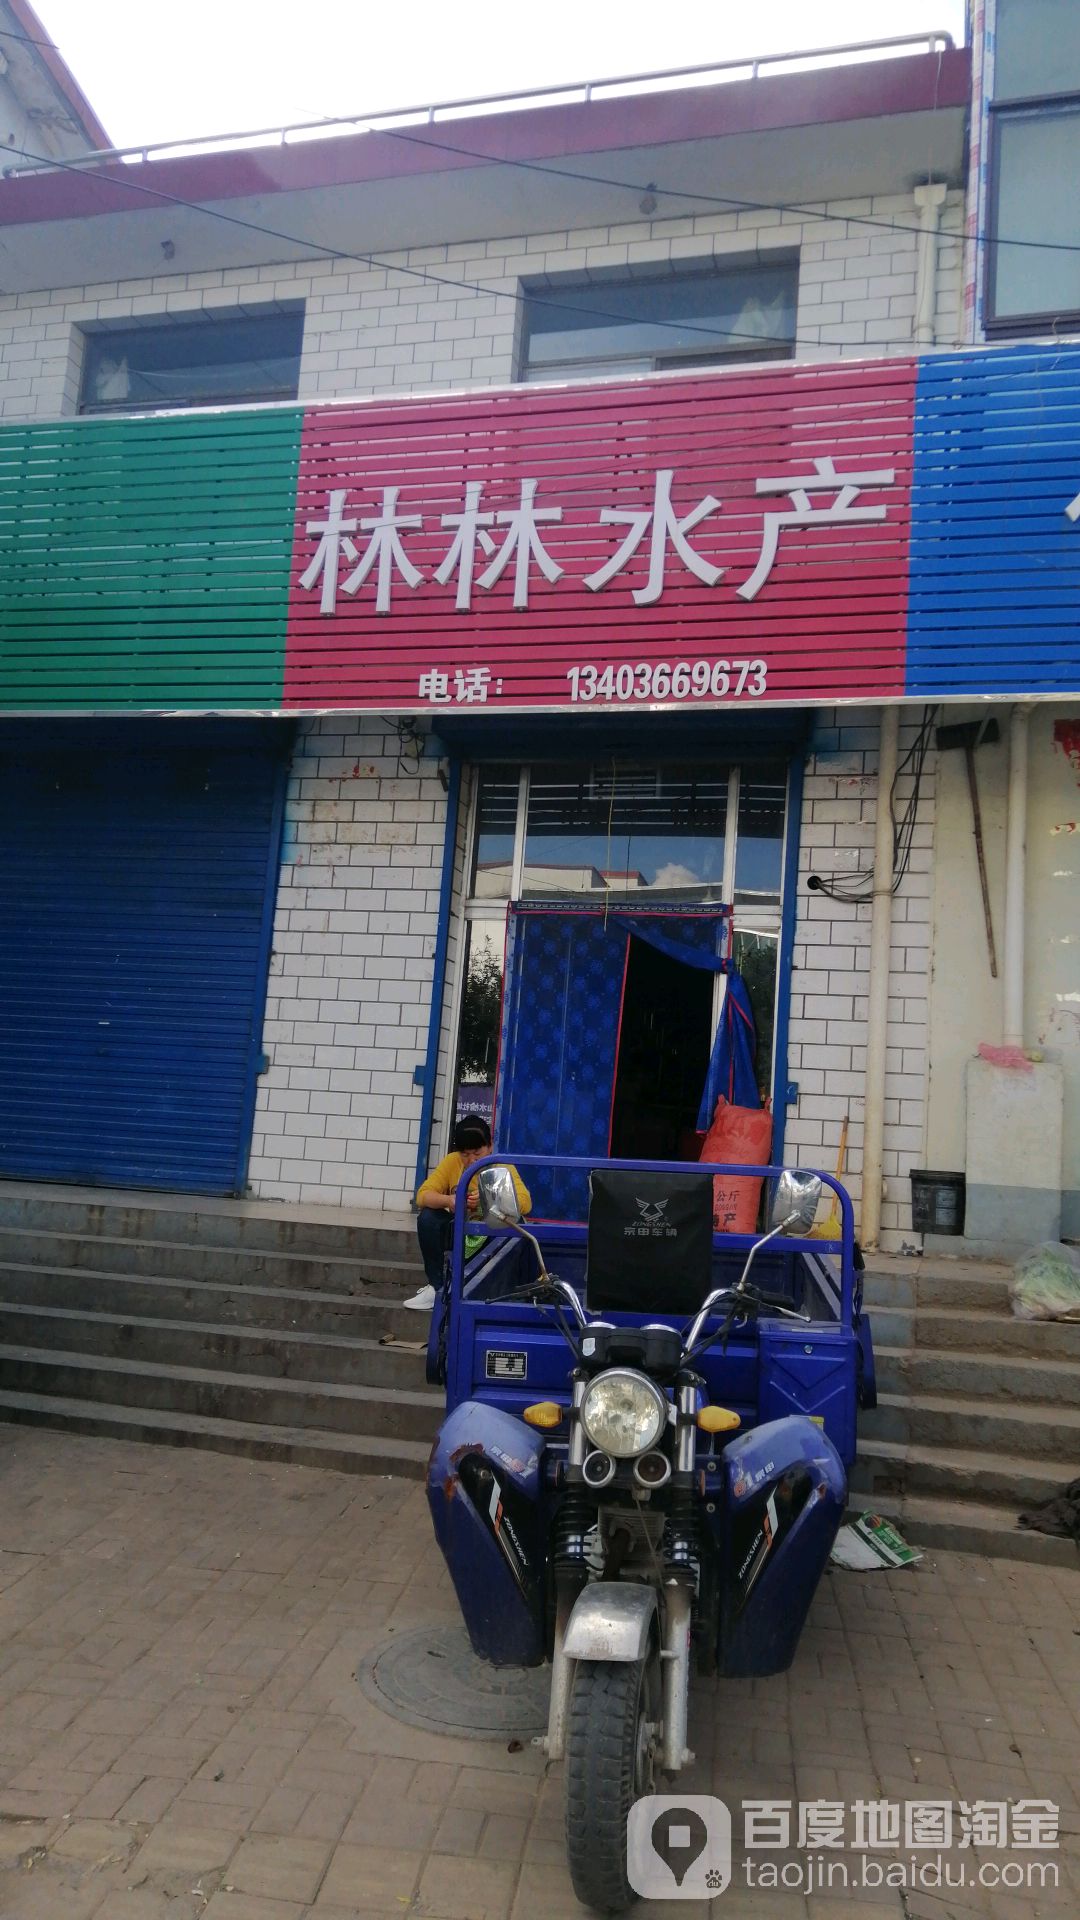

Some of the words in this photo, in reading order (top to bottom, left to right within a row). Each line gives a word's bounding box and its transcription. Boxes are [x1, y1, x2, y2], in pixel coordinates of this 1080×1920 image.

[299, 457, 895, 616] 林林水产
[567, 660, 767, 701] 13403669673
[738, 1529, 763, 1579] ZONGSHEN
